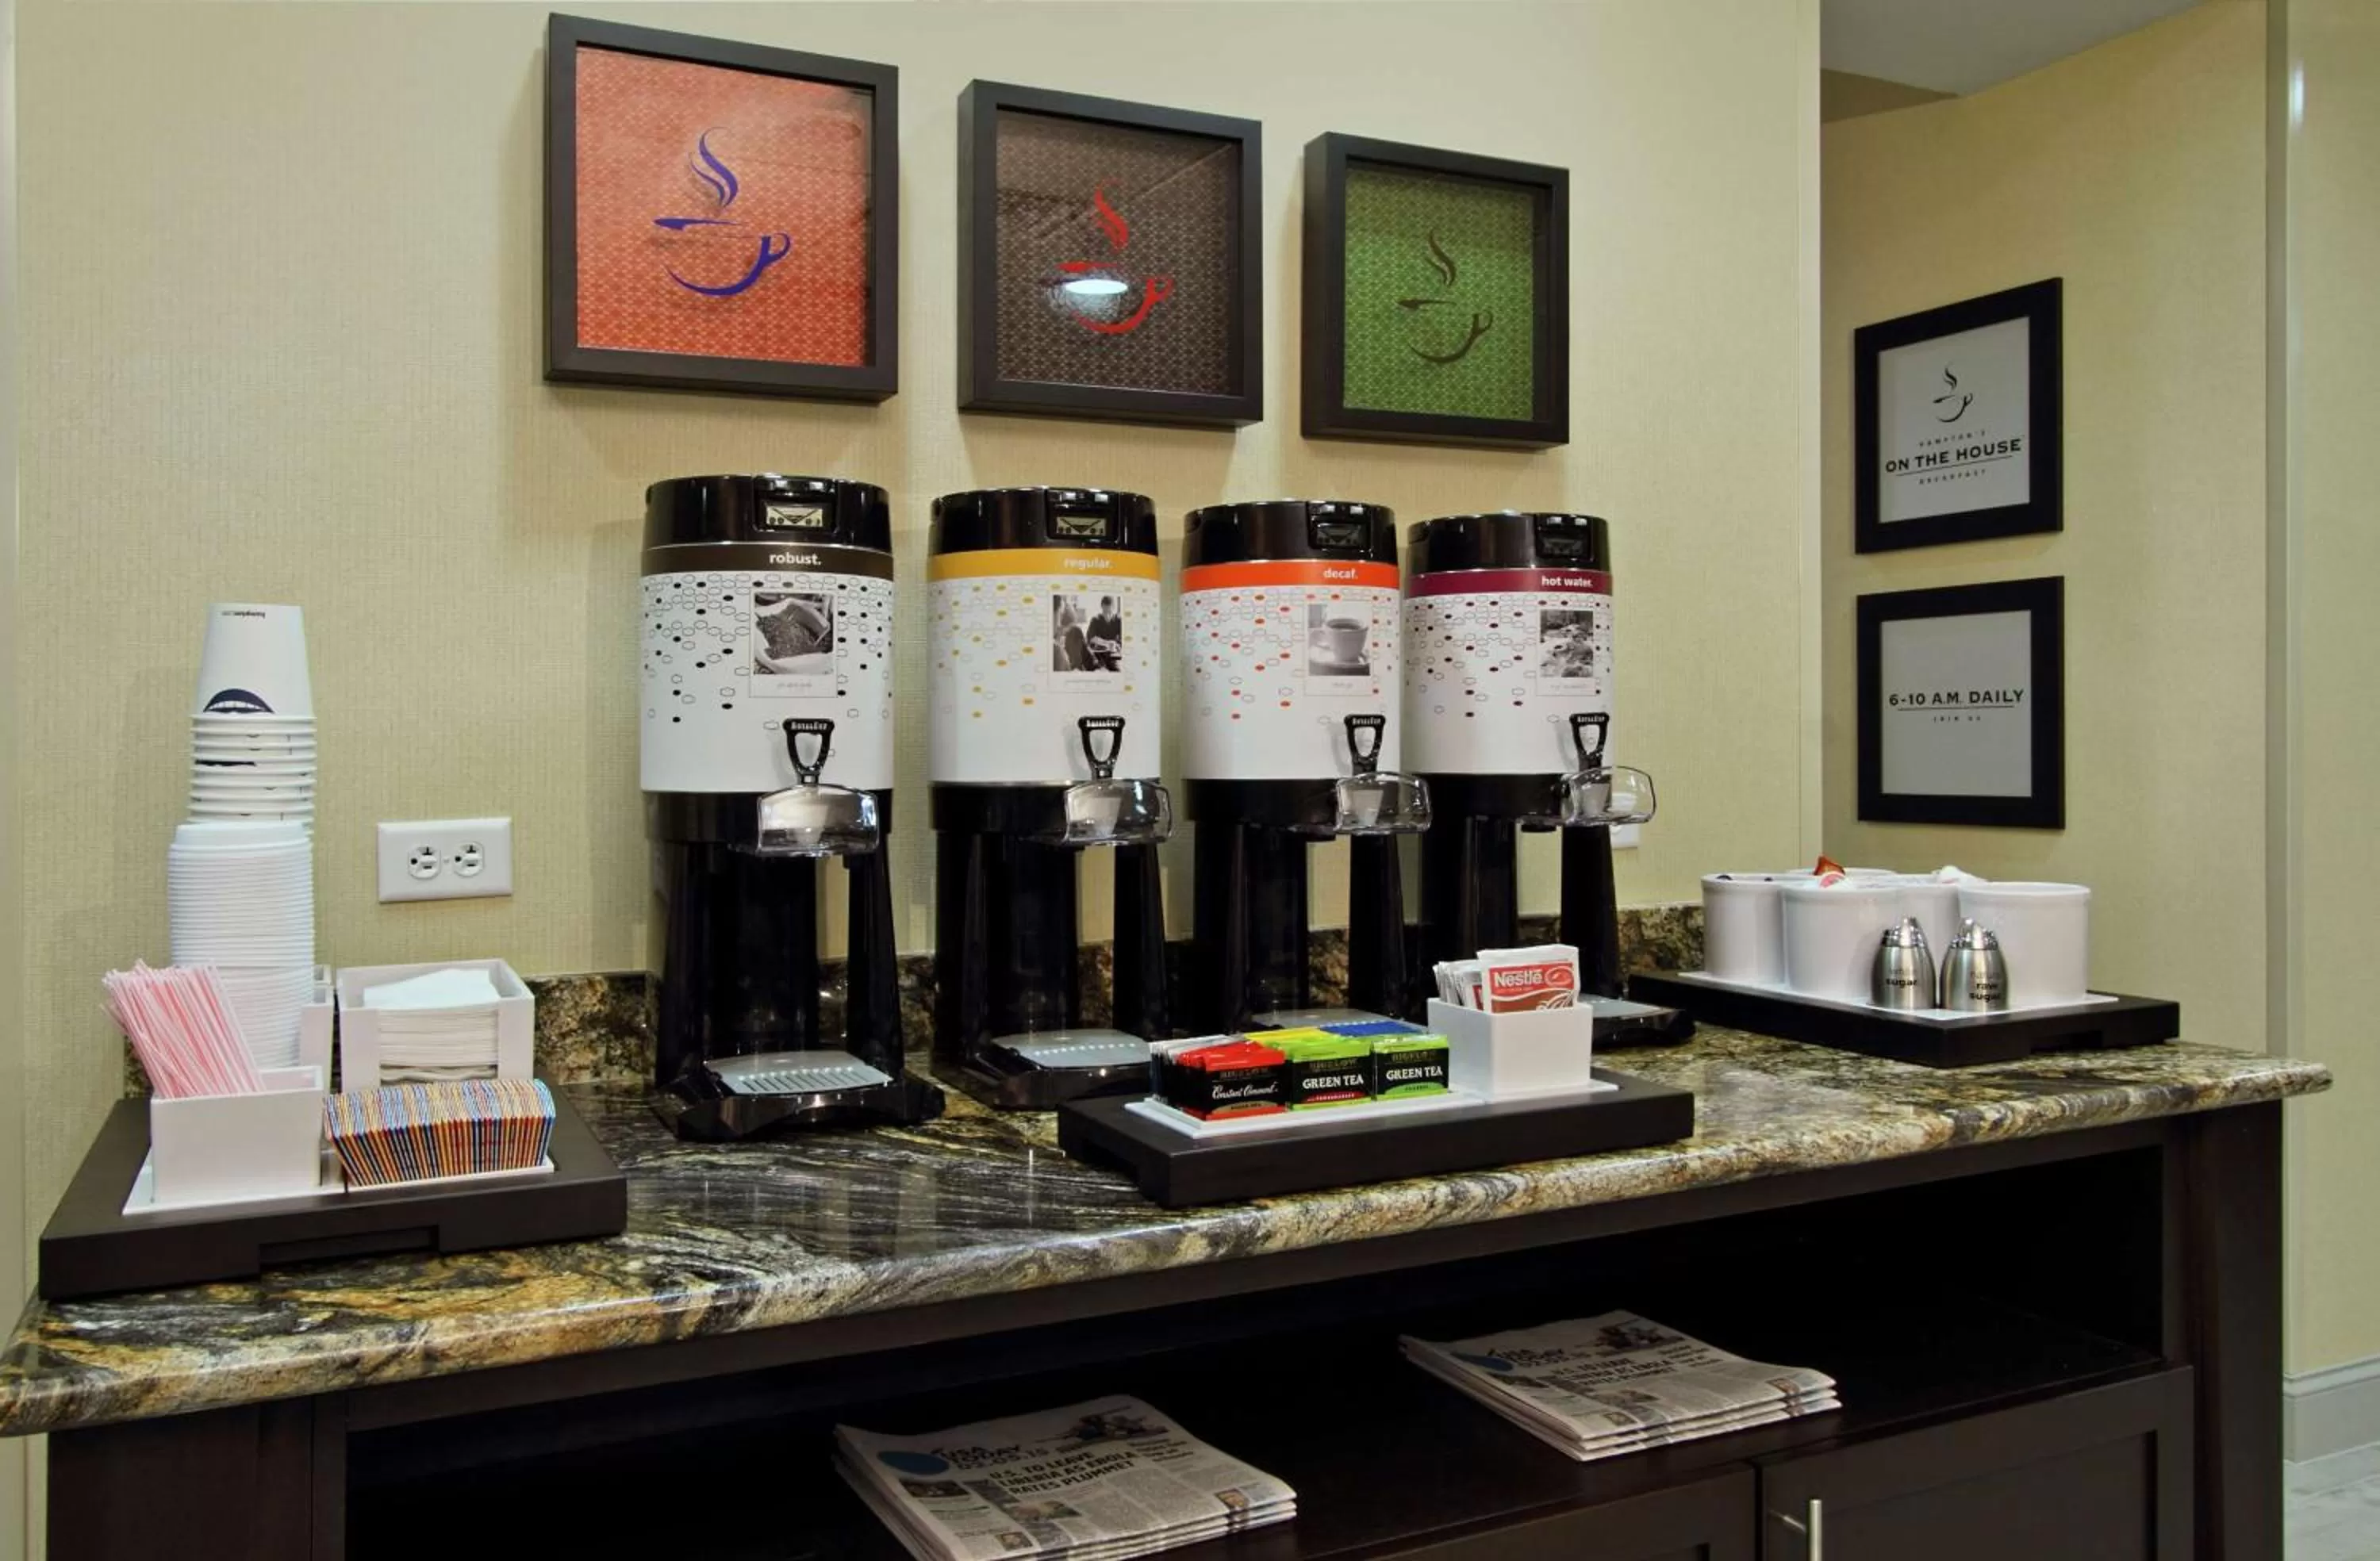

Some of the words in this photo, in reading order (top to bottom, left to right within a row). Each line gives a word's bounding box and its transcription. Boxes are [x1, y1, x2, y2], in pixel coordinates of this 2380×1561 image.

[1886, 457, 1909, 473] ON
[1914, 451, 1949, 468] THE
[1956, 439, 2022, 462] HOUSE
[769, 551, 821, 566] robust.
[1064, 558, 1113, 570] regular.
[1322, 568, 1358, 580] decaf.
[1541, 575, 1561, 587] hot
[1889, 692, 1925, 706] 6-10
[1969, 688, 2024, 704] DAILY
[1386, 1068, 1422, 1082] GREEN
[1424, 1065, 1443, 1077] TEA
[1302, 1076, 1342, 1090] GREEN
[1342, 1074, 1365, 1087] TEA
[1046, 1452, 1095, 1467] LEAVE
[1085, 1451, 1138, 1467] EBOLA
[1061, 1460, 1135, 1486] PLUMMET
